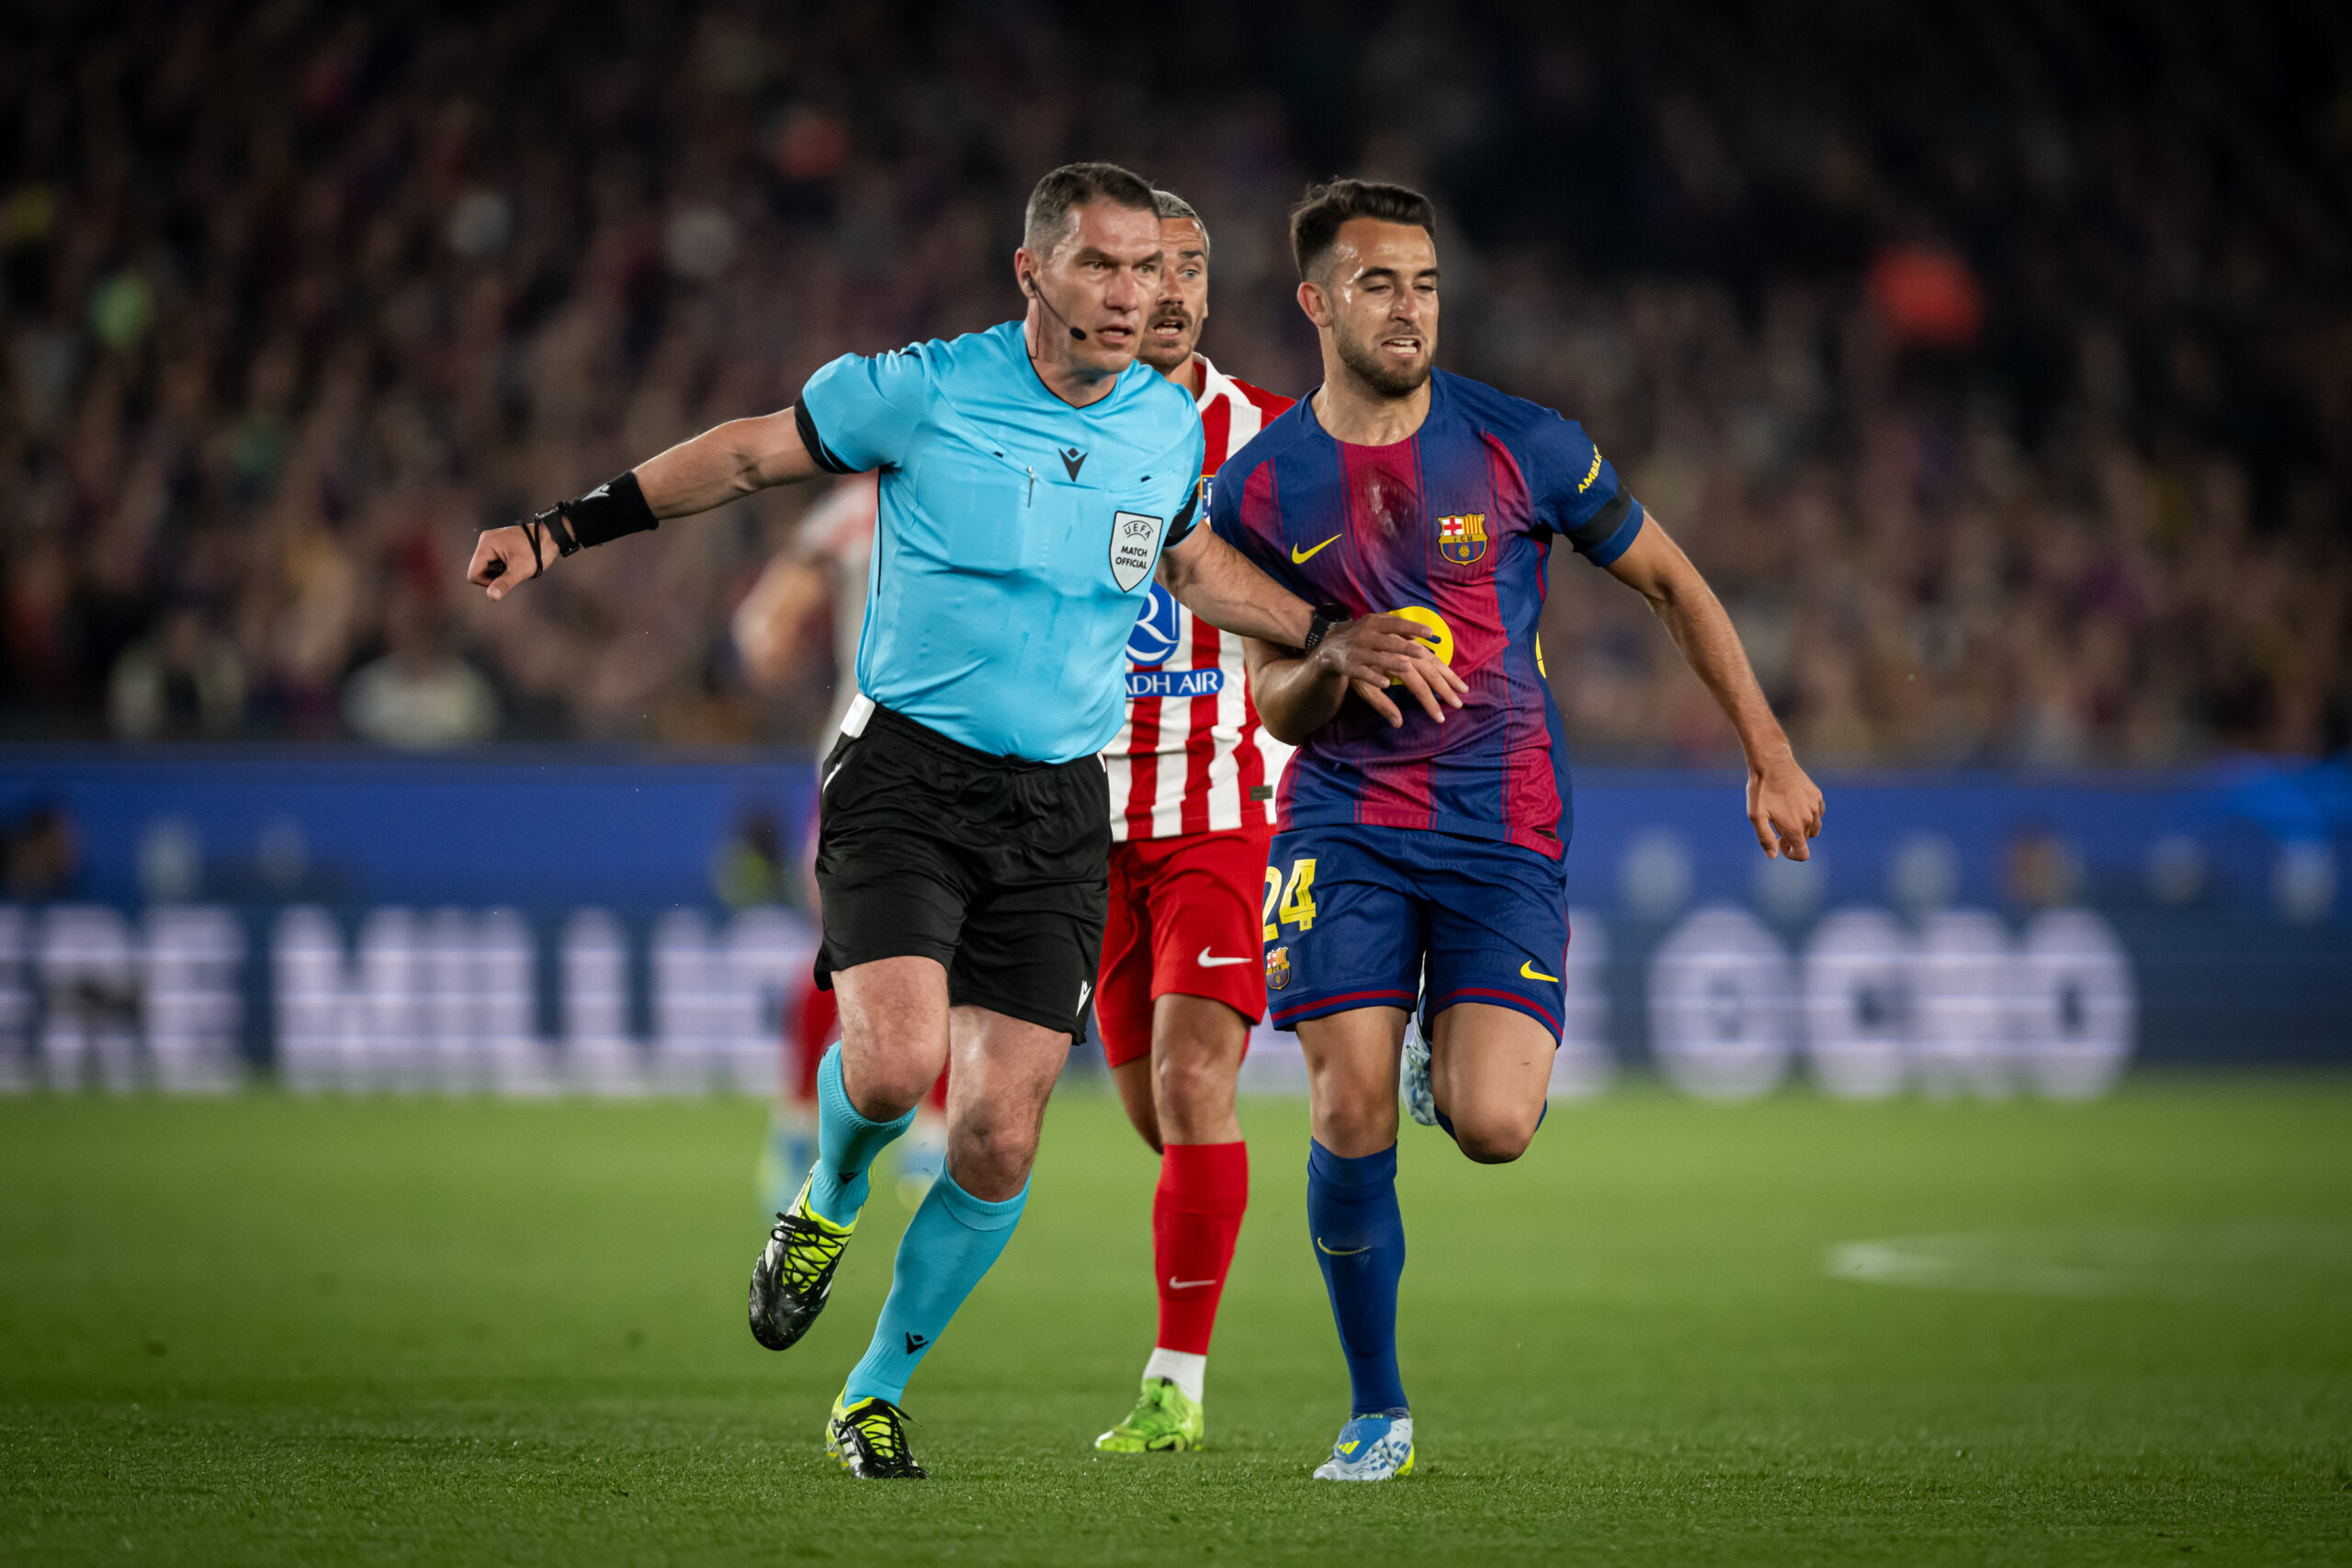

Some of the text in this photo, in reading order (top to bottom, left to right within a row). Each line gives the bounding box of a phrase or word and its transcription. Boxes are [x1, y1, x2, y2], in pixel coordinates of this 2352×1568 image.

[1124, 523, 1151, 539] UEFA
[1120, 545, 1148, 558] MATCH
[1114, 556, 1148, 570] OFFICIAL
[1178, 671, 1219, 694] AIR
[1262, 858, 1317, 943] 24
